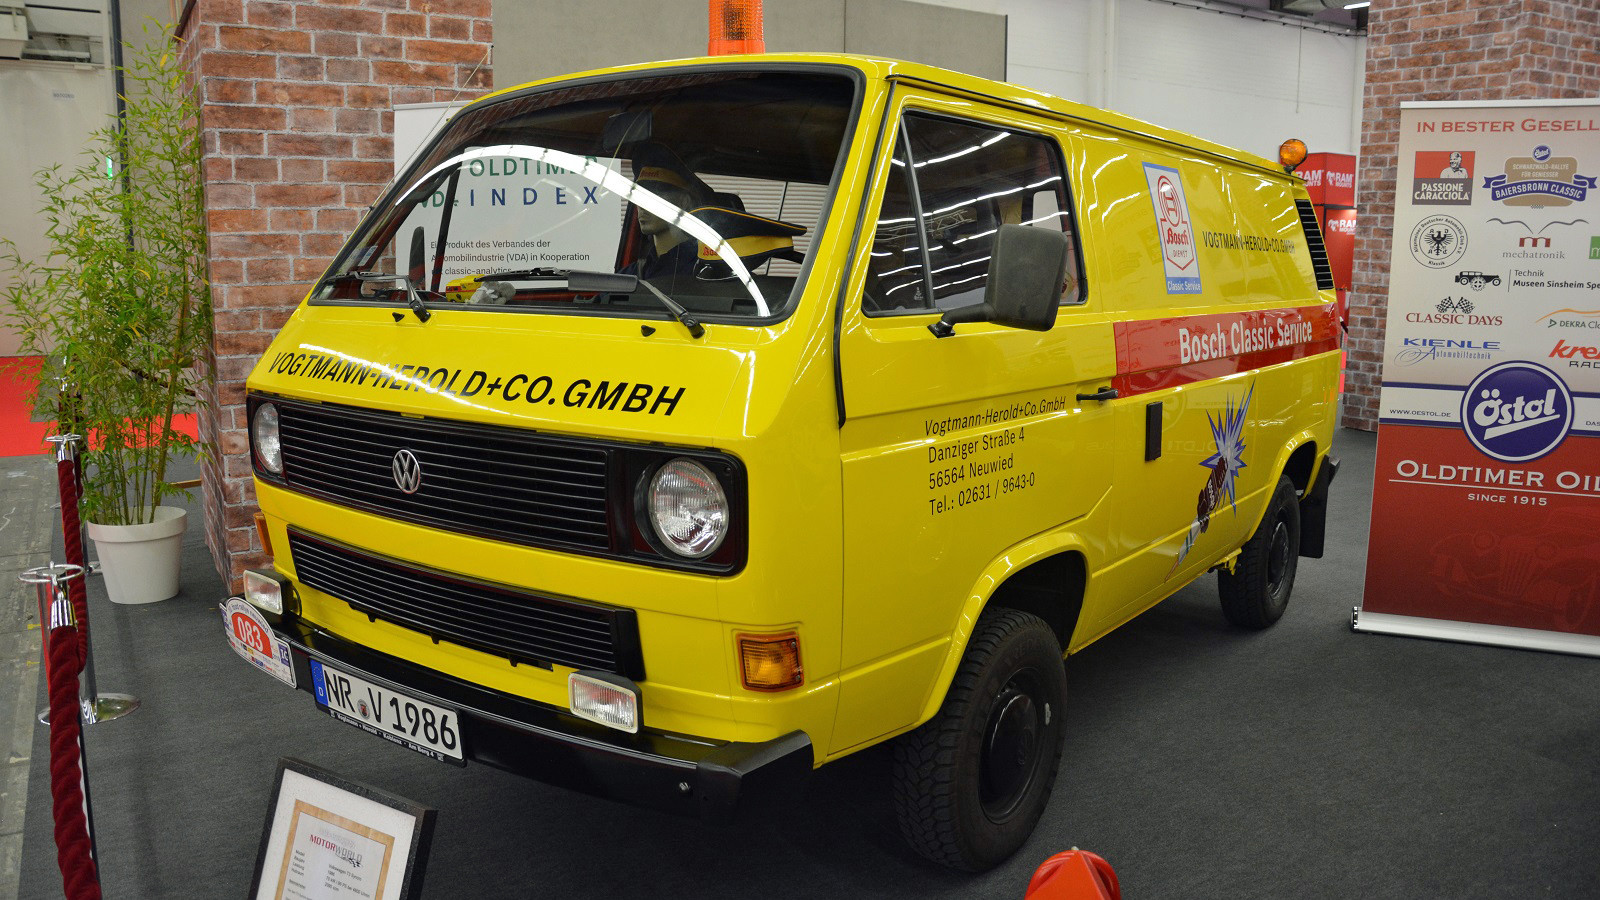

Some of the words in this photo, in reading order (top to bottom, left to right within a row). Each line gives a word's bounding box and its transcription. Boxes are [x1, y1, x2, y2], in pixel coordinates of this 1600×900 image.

[1417, 121, 1435, 133] IN
[1441, 121, 1515, 133] BESTER
[1421, 182, 1464, 192] PASSIONE
[1495, 182, 1548, 199] BAIERSBRONN
[1550, 183, 1583, 199] CLASSIC
[470, 186, 598, 207] INDEX
[1414, 191, 1469, 201] CARACCIOLA
[1166, 227, 1190, 246] Bosch
[475, 240, 490, 249] des
[492, 240, 535, 249] Verbandes
[536, 240, 551, 248] der
[431, 252, 505, 262] Aomobilindustrie
[506, 252, 529, 262] (VDA)
[530, 253, 538, 261] in
[540, 252, 590, 263] Kooperation
[1502, 250, 1566, 259] mechatronik
[1514, 269, 1545, 277] Technik
[1167, 280, 1184, 291] Classic
[1184, 281, 1200, 291] Service
[1513, 280, 1545, 288] Museen
[1547, 280, 1584, 288] Sinsheim
[1406, 312, 1465, 325] CLASSIC
[1467, 314, 1503, 326] DAYS
[1559, 320, 1586, 328] DEKRA
[1178, 323, 1227, 364] Bosch
[1230, 319, 1274, 354] Classic
[1276, 314, 1313, 347] Service
[1403, 337, 1500, 350] KIENLE
[268, 351, 687, 416] VOGTMANN-HEROLD+CO.GMBH
[1389, 409, 1452, 418] WWW.OESTOL.DE
[1473, 388, 1558, 427] Östol
[925, 396, 1067, 436] Vogtmann-Herold+Co.GmbH
[928, 437, 979, 463] Danziger
[982, 430, 1016, 451] Straße
[1018, 427, 1025, 442] 4
[929, 465, 965, 490] 56564
[969, 453, 1014, 478] Neuwied
[1396, 459, 1545, 488] OLDTIMER
[929, 495, 954, 515] Tel.:
[958, 482, 991, 507] 02631
[994, 480, 1000, 499] /
[1002, 471, 1035, 494] 9643-0
[1467, 493, 1506, 503] SINCE
[1513, 496, 1548, 506] 1915
[237, 616, 264, 652] 083
[324, 669, 356, 713] NR
[367, 687, 383, 723] V
[389, 696, 457, 751] 1986
[309, 834, 363, 863] MOTORWORLD
